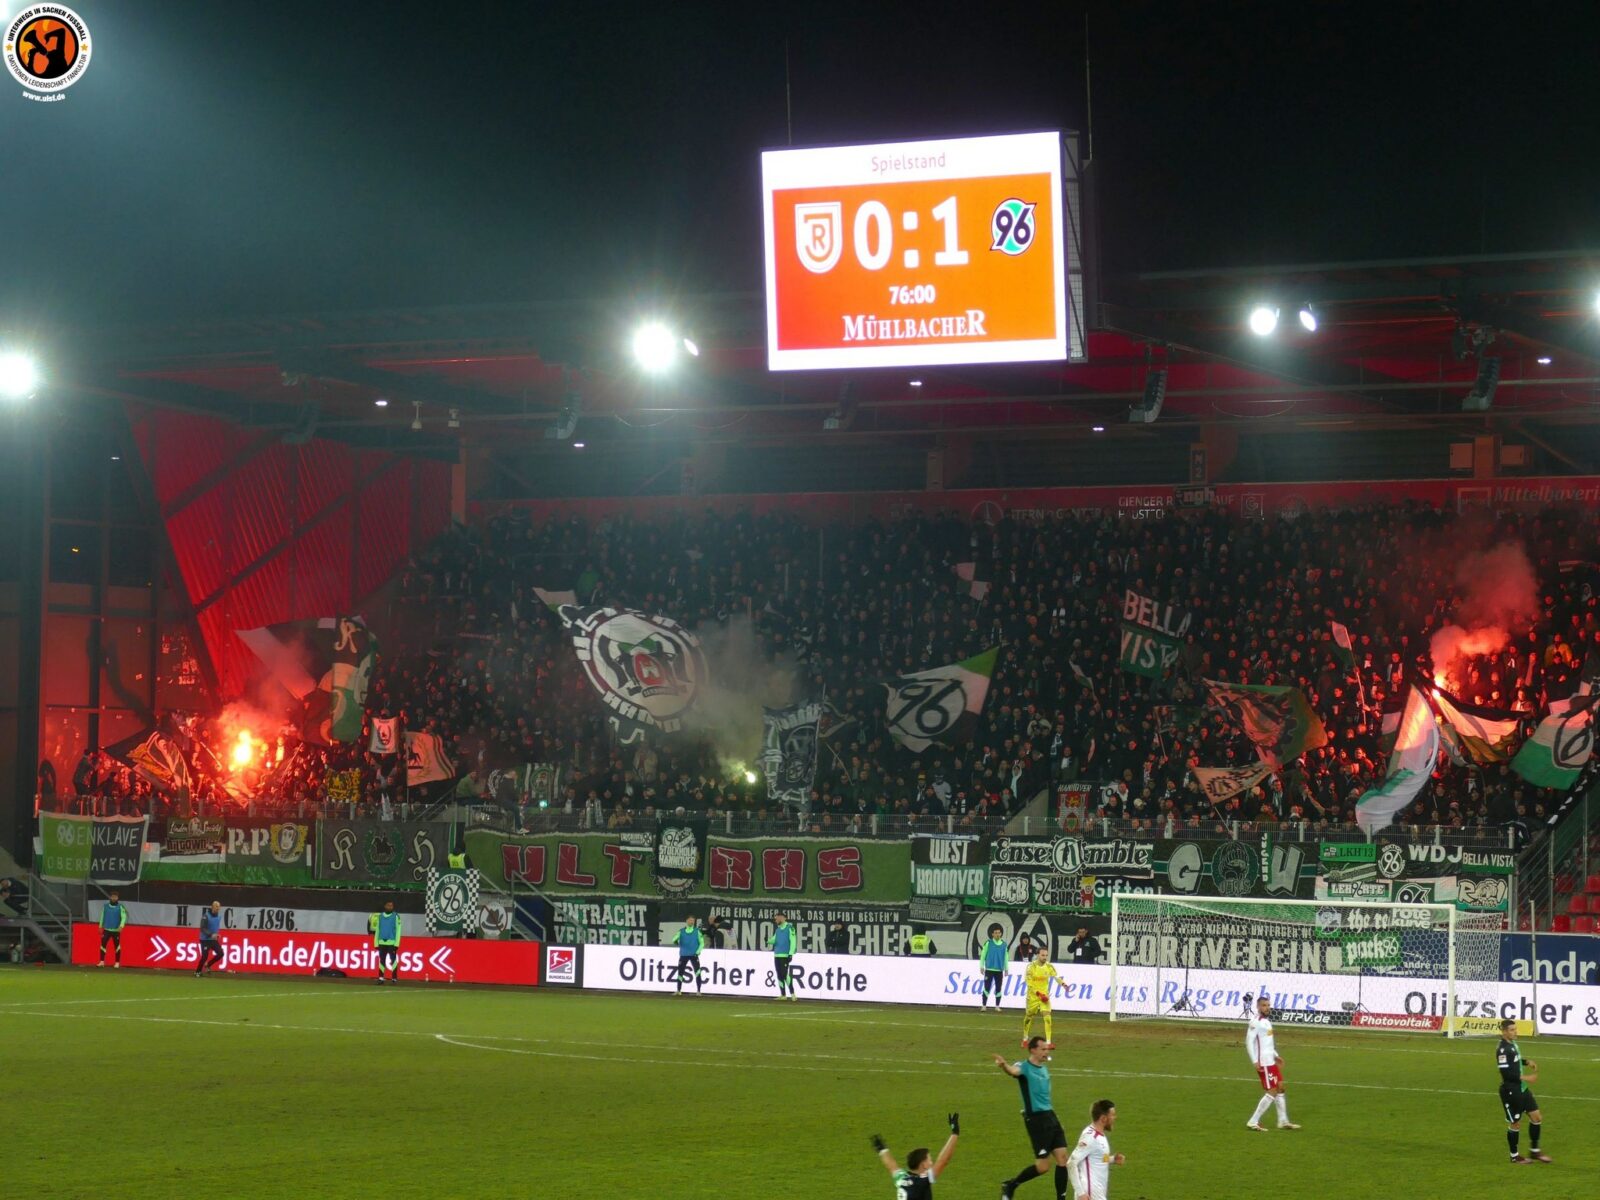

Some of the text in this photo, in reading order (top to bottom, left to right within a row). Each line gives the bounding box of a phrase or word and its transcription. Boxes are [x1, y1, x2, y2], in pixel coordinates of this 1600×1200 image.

[871, 152, 946, 175] Spielstand
[992, 203, 1035, 250] 96
[889, 284, 936, 305] 76:00
[1123, 589, 1192, 638] BELLA
[77, 827, 140, 848] ENKLAVE
[659, 845, 698, 857] STOCKHOLM
[929, 838, 971, 865] WEST
[1383, 851, 1400, 872] 96
[1463, 852, 1514, 868] BELLA VISTA
[47, 856, 137, 872] OBERBAYERN
[659, 856, 697, 868] HANNOVER
[444, 875, 461, 884] HSV
[916, 868, 984, 895] HANNOVER
[443, 885, 461, 913] 96
[553, 902, 647, 927] EINTRACHT
[710, 906, 731, 918] ABER
[808, 911, 824, 921] DAS
[828, 911, 856, 922] BLEIBT
[1392, 907, 1432, 920] rote
[1206, 923, 1247, 936] NIEMALS
[1098, 933, 1321, 973] SPORTVEREIN
[564, 963, 572, 973] 2
[619, 957, 868, 992] Olitzscher & Rothe
[1511, 951, 1598, 983] andr
[944, 971, 1093, 1000] Stalhllen
[1105, 985, 1148, 1003] aus
[1281, 1013, 1331, 1024] BTPV.de
[1360, 1016, 1432, 1029] Photovoltaik
